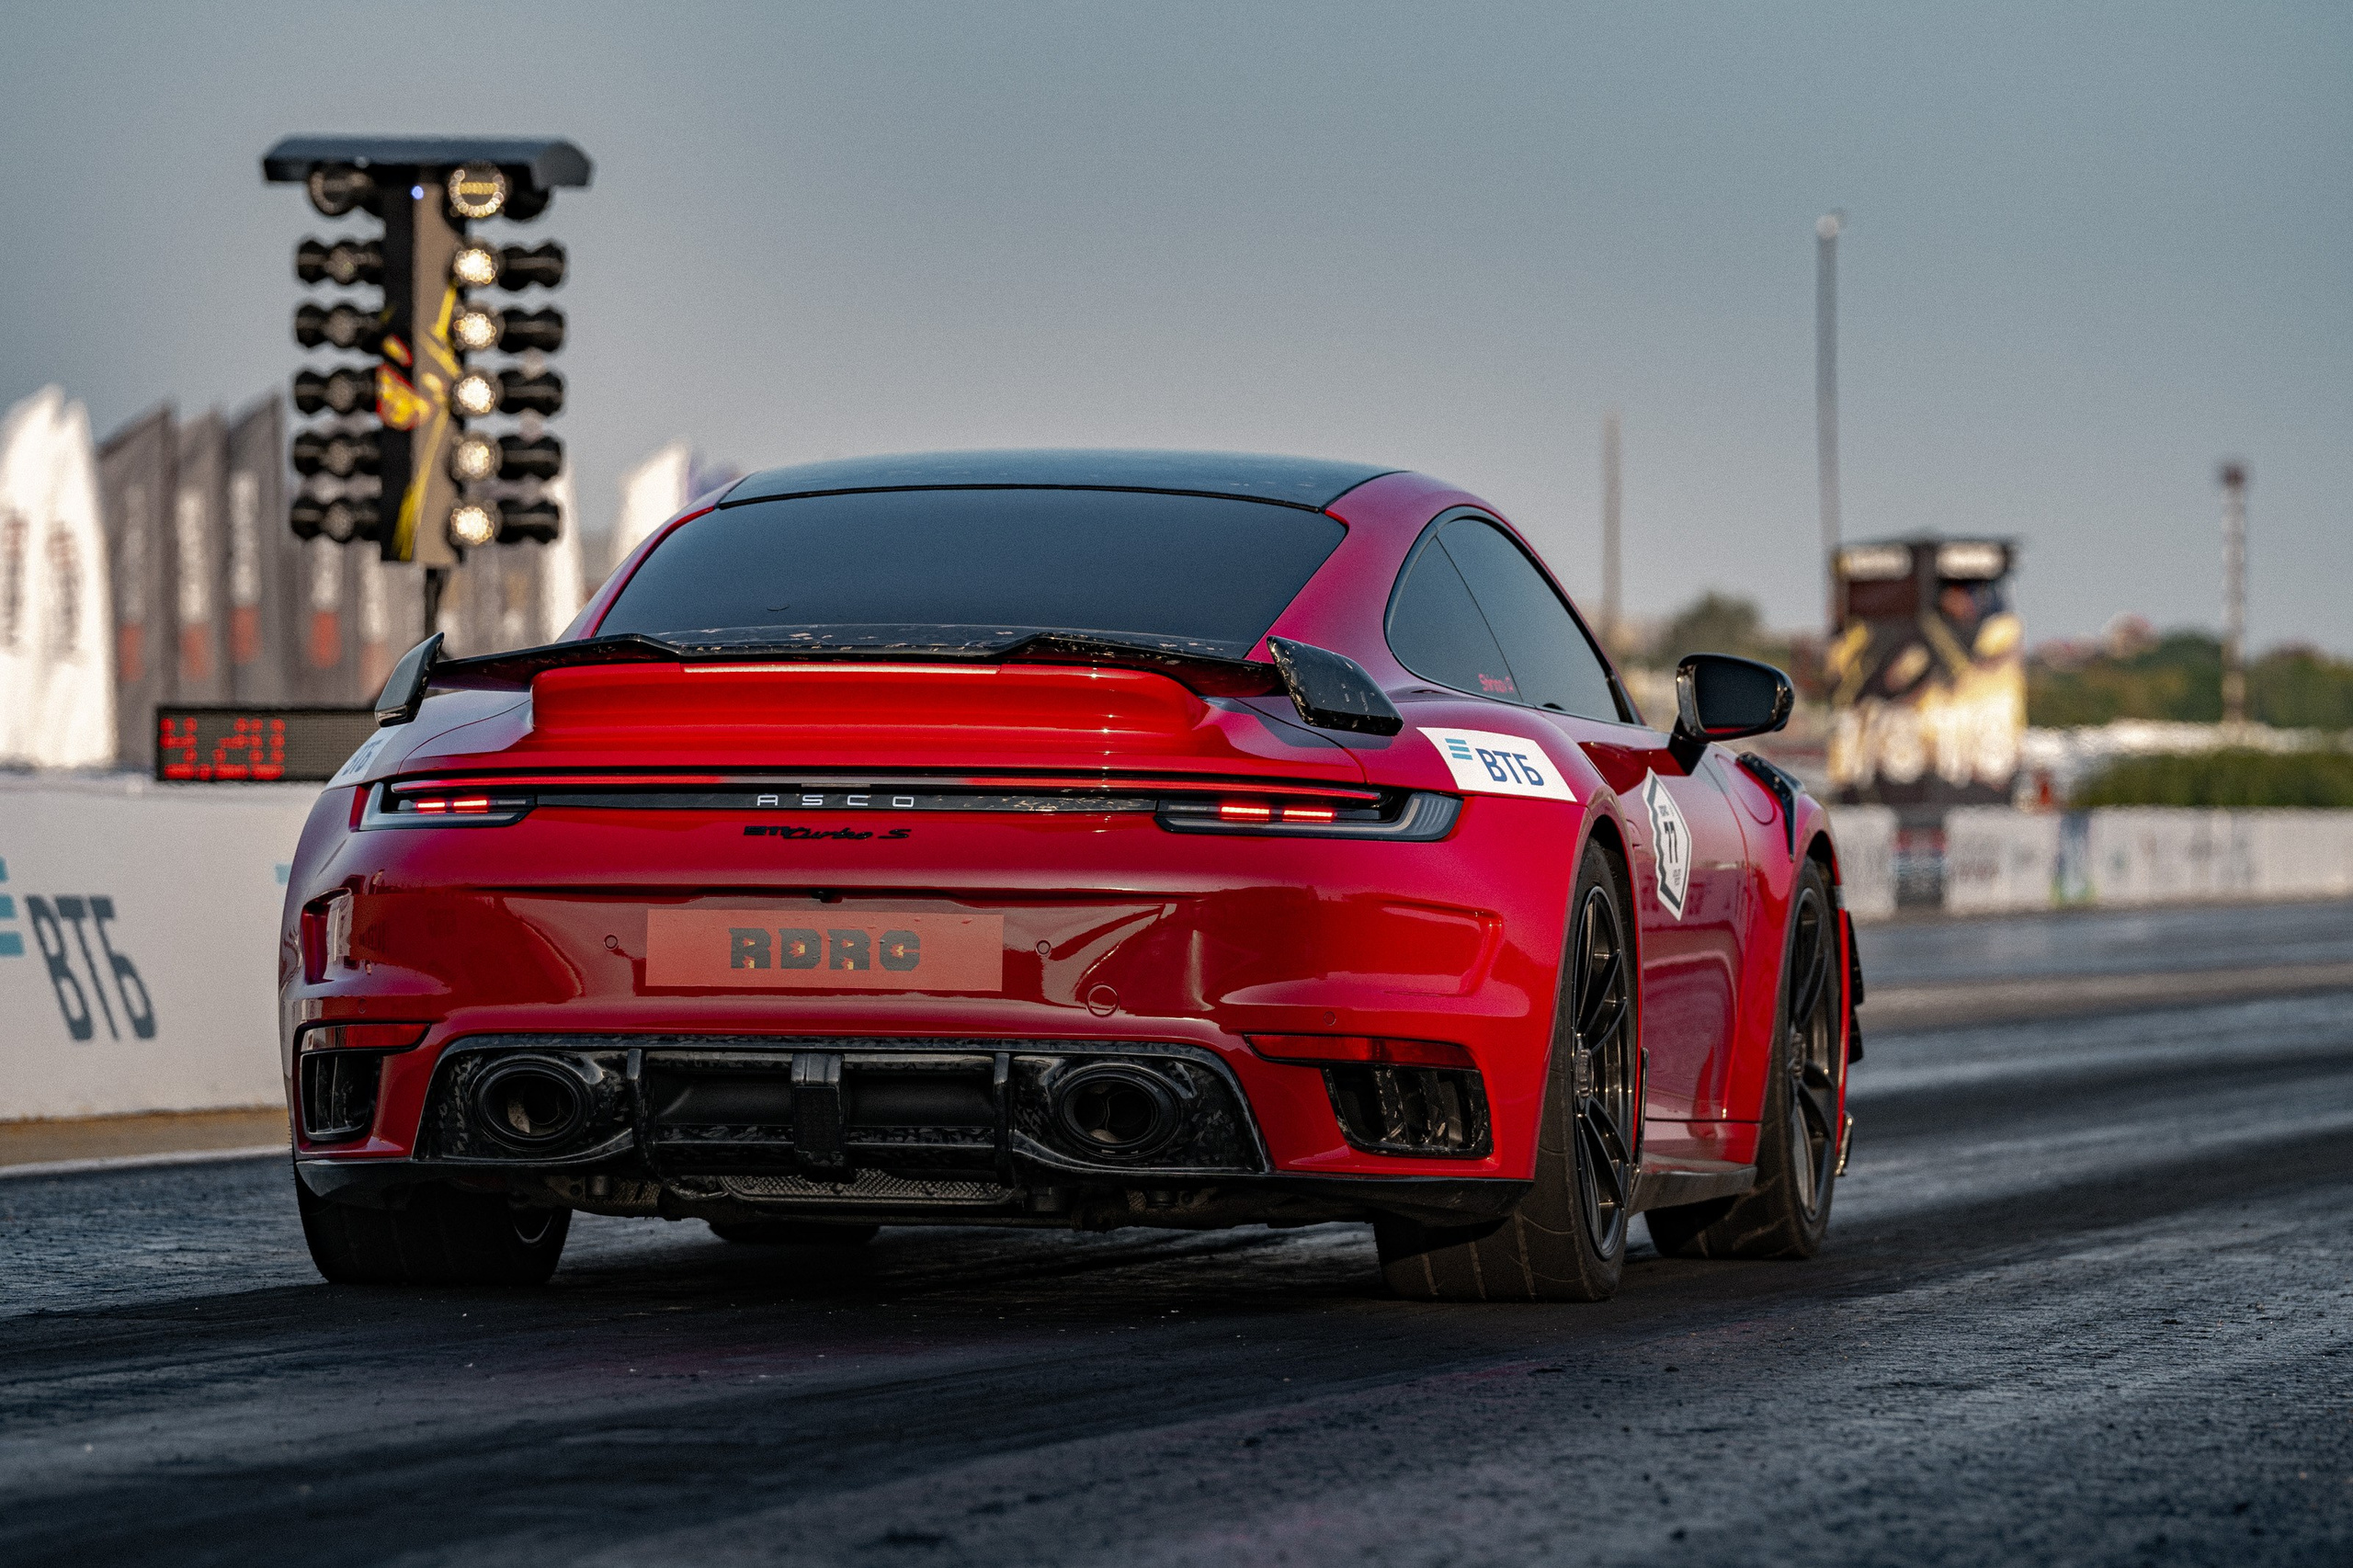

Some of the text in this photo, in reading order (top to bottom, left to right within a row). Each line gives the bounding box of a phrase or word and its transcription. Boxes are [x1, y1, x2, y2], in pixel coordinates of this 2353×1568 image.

[1475, 747, 1545, 787] ВТБ
[756, 794, 915, 808] ASCO
[783, 826, 873, 840] Turbo
[878, 829, 912, 839] S
[25, 894, 156, 1041] ВТБ
[728, 927, 921, 971] RDRC
